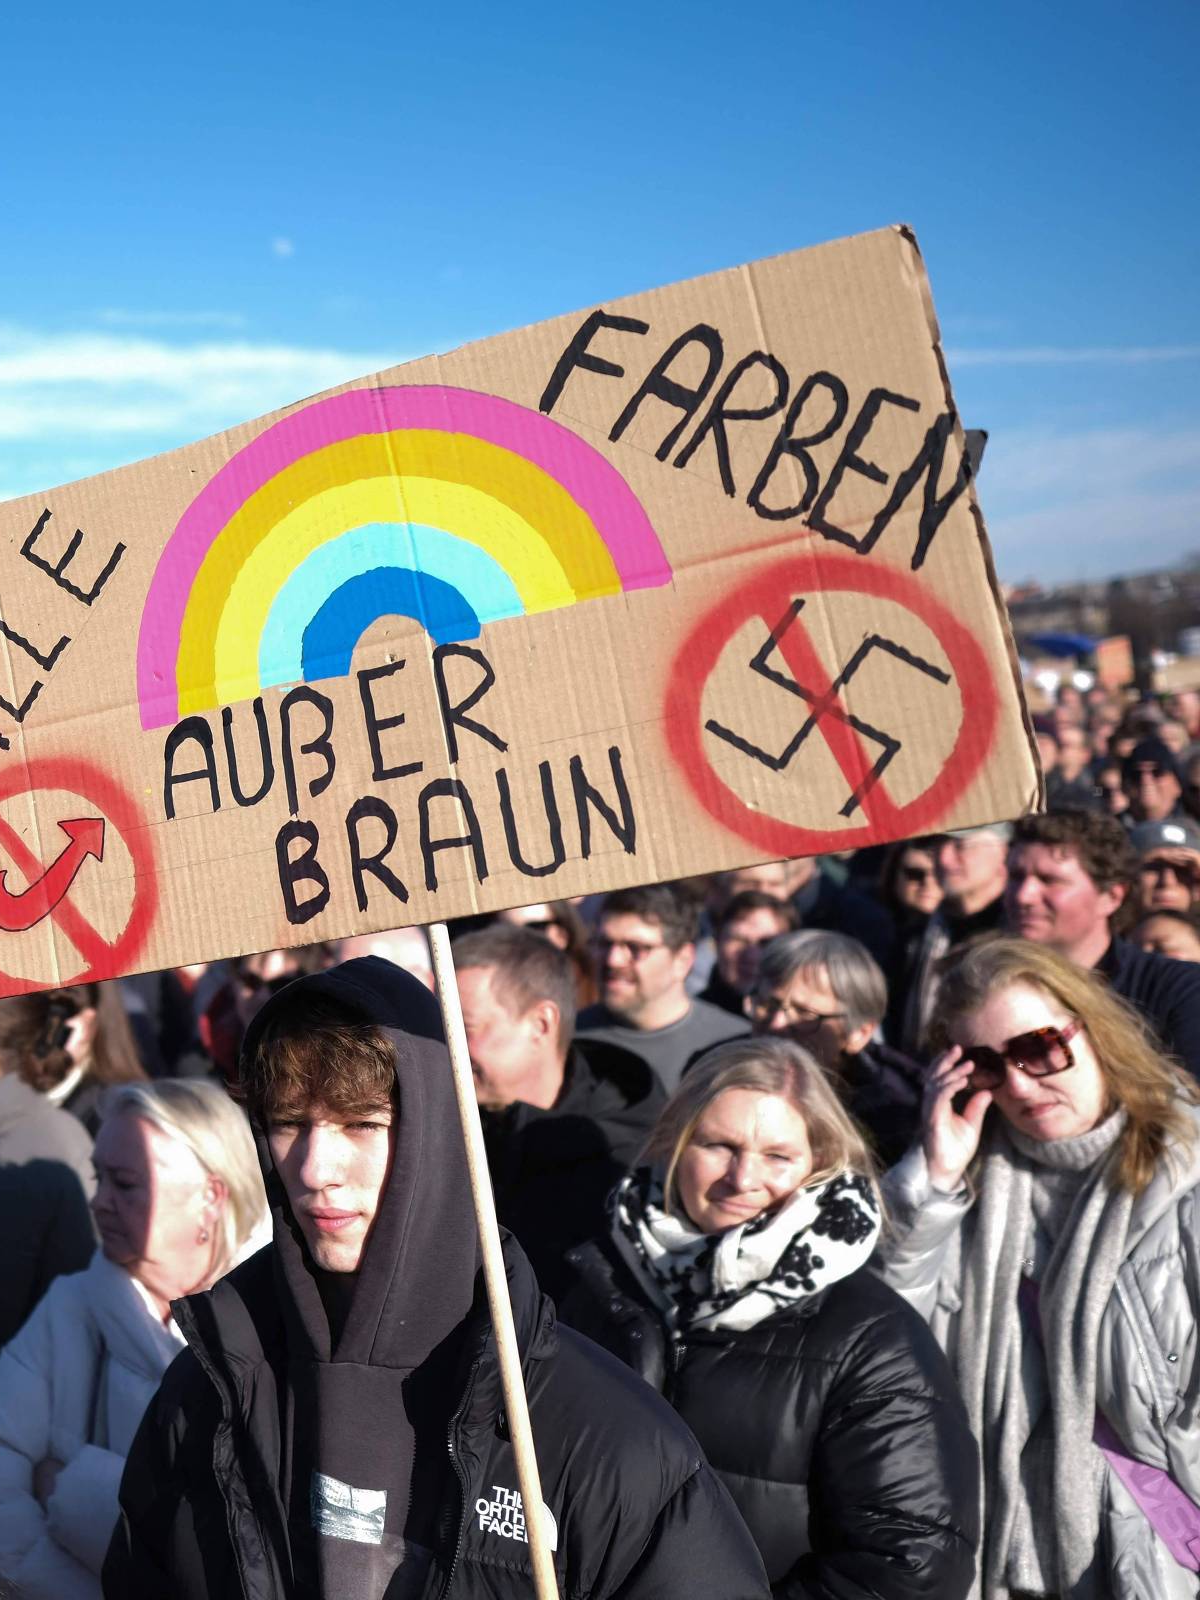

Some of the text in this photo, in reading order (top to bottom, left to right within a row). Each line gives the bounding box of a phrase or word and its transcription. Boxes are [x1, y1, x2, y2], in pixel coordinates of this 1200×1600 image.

[539, 309, 988, 571] FARBEN
[164, 642, 508, 818] AUßER
[275, 745, 637, 925] BRAUN
